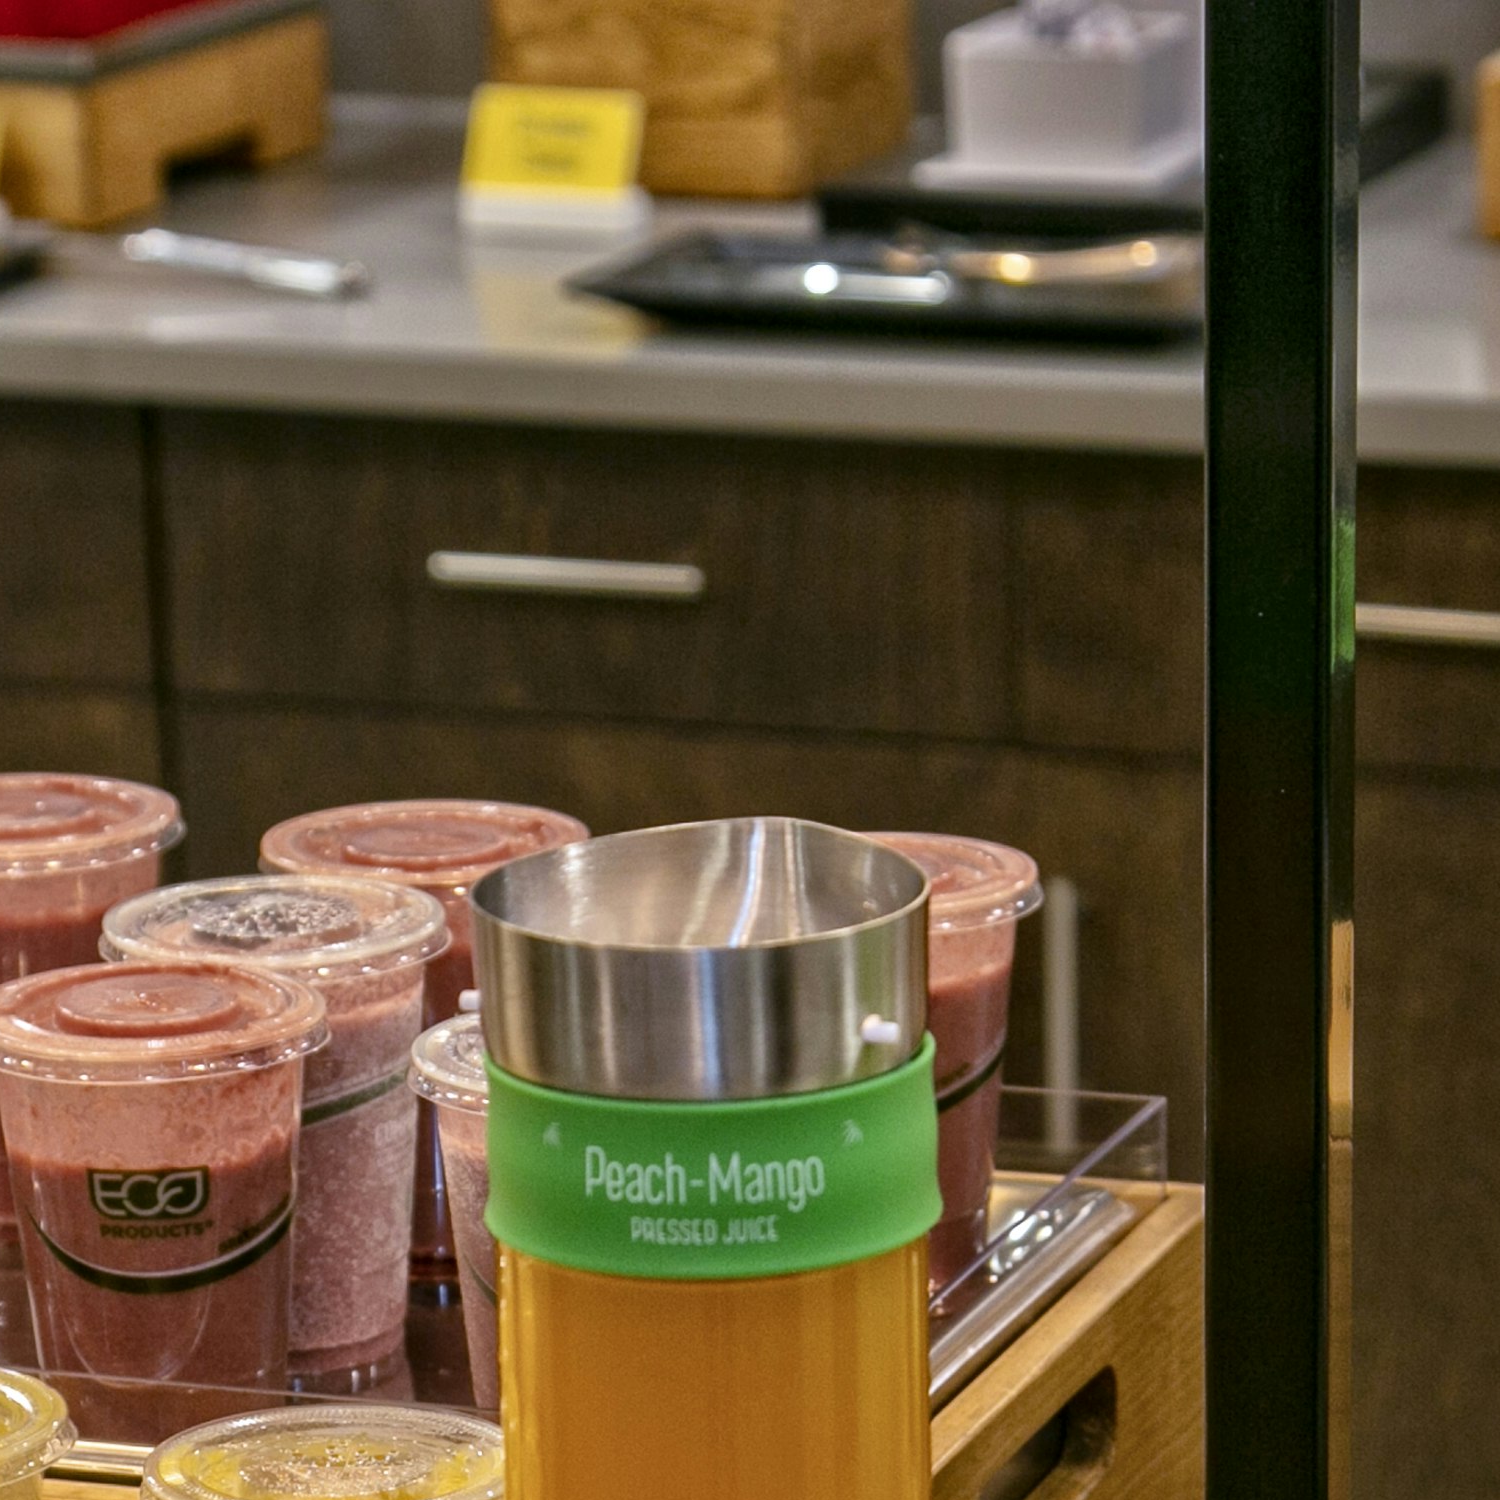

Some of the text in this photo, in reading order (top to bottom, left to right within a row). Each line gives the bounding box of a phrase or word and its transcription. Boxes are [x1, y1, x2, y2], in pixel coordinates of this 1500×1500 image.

[92, 1170, 204, 1217] ECO
[584, 1145, 826, 1214] Peach-Mango
[629, 1214, 780, 1245] PRESSED JUICE
